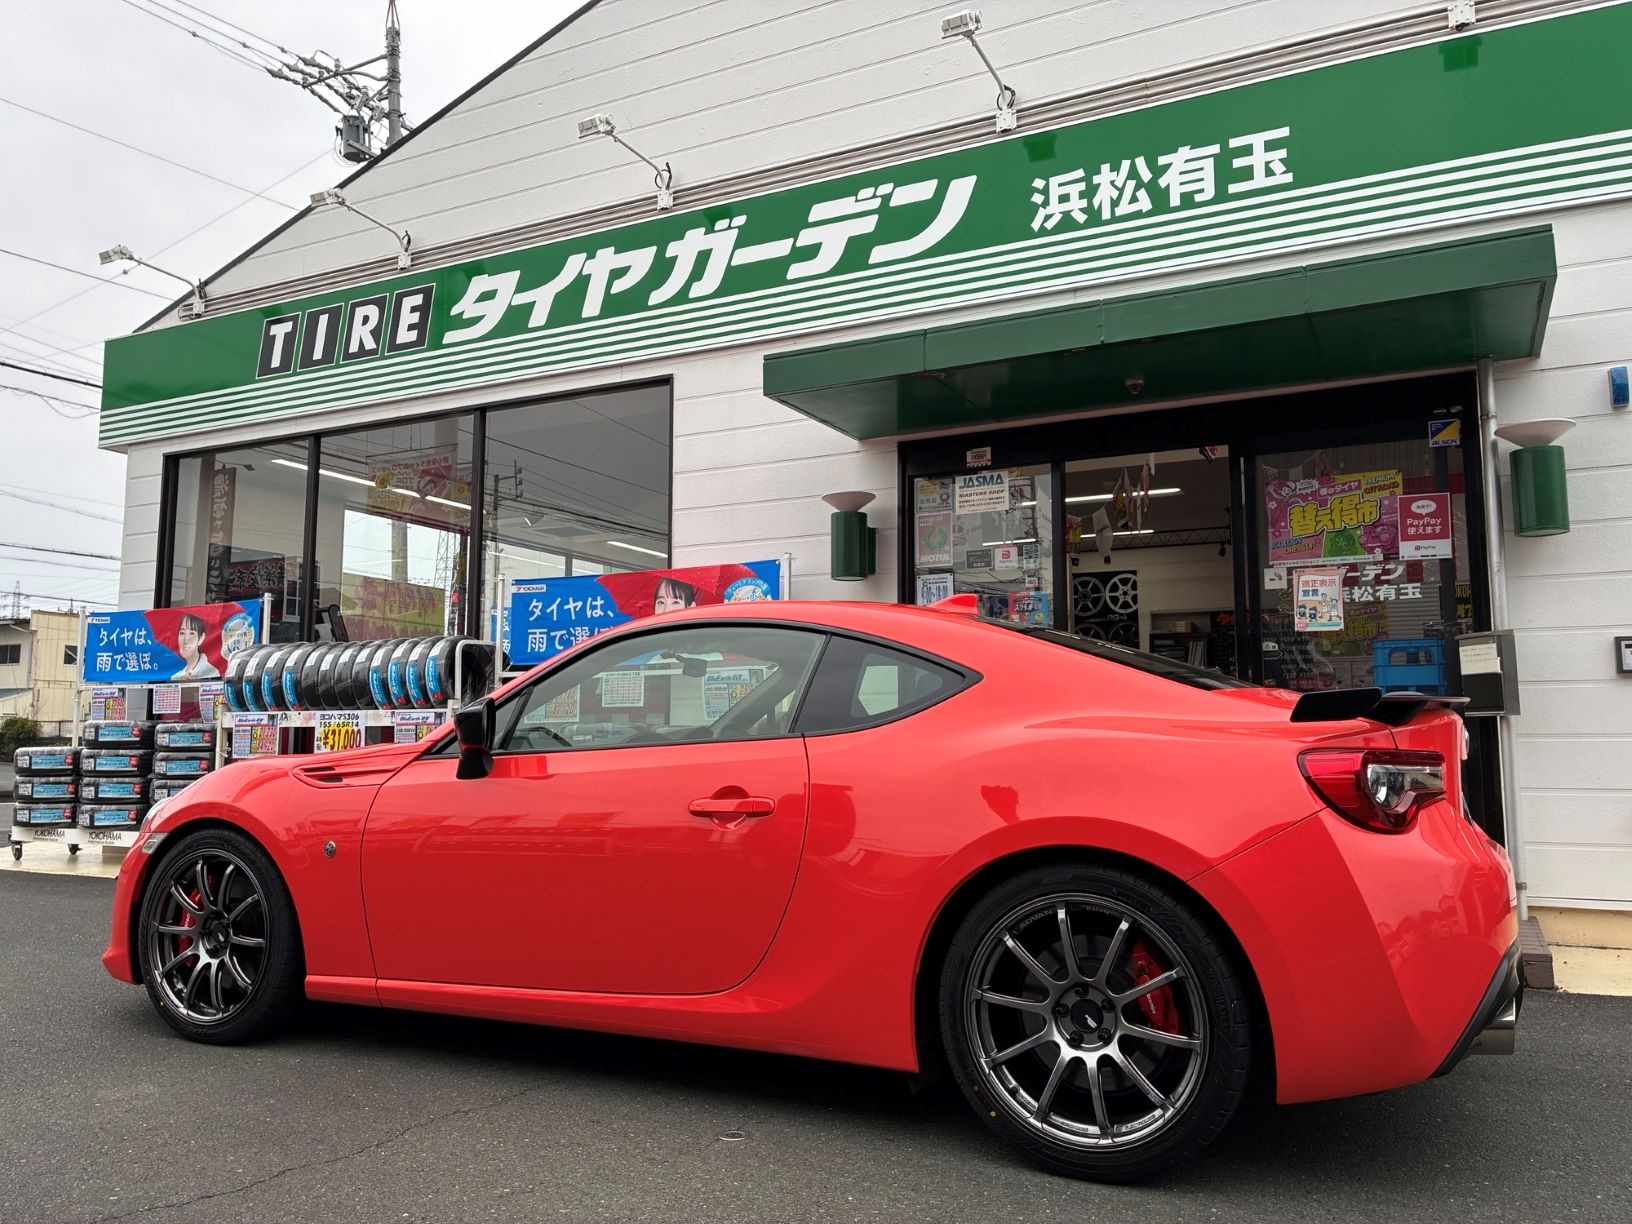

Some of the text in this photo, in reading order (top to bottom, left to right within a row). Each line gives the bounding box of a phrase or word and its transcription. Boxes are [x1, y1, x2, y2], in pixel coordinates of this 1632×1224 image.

[1029, 125, 1294, 232] 浜松有玉
[442, 174, 978, 345] タイヤガーデン
[269, 292, 425, 369] TIRE
[958, 473, 1004, 490] JASMA
[959, 490, 987, 498] MASTERS
[1289, 494, 1379, 537] 替え得市
[1407, 517, 1441, 526] PayPay
[1408, 525, 1442, 535] 使えます
[919, 553, 951, 563] MOTUL
[1341, 563, 1405, 582] ーデン
[528, 596, 615, 621] タイヤは、
[99, 627, 153, 647] タイヤは、
[527, 626, 613, 652] 雨で選
[96, 651, 159, 672] 雨で選ぼ。
[320, 713, 359, 721] ヨコハマS306
[34, 829, 66, 838] YOKOHAMA
[88, 832, 122, 841] YOKOHAMA
